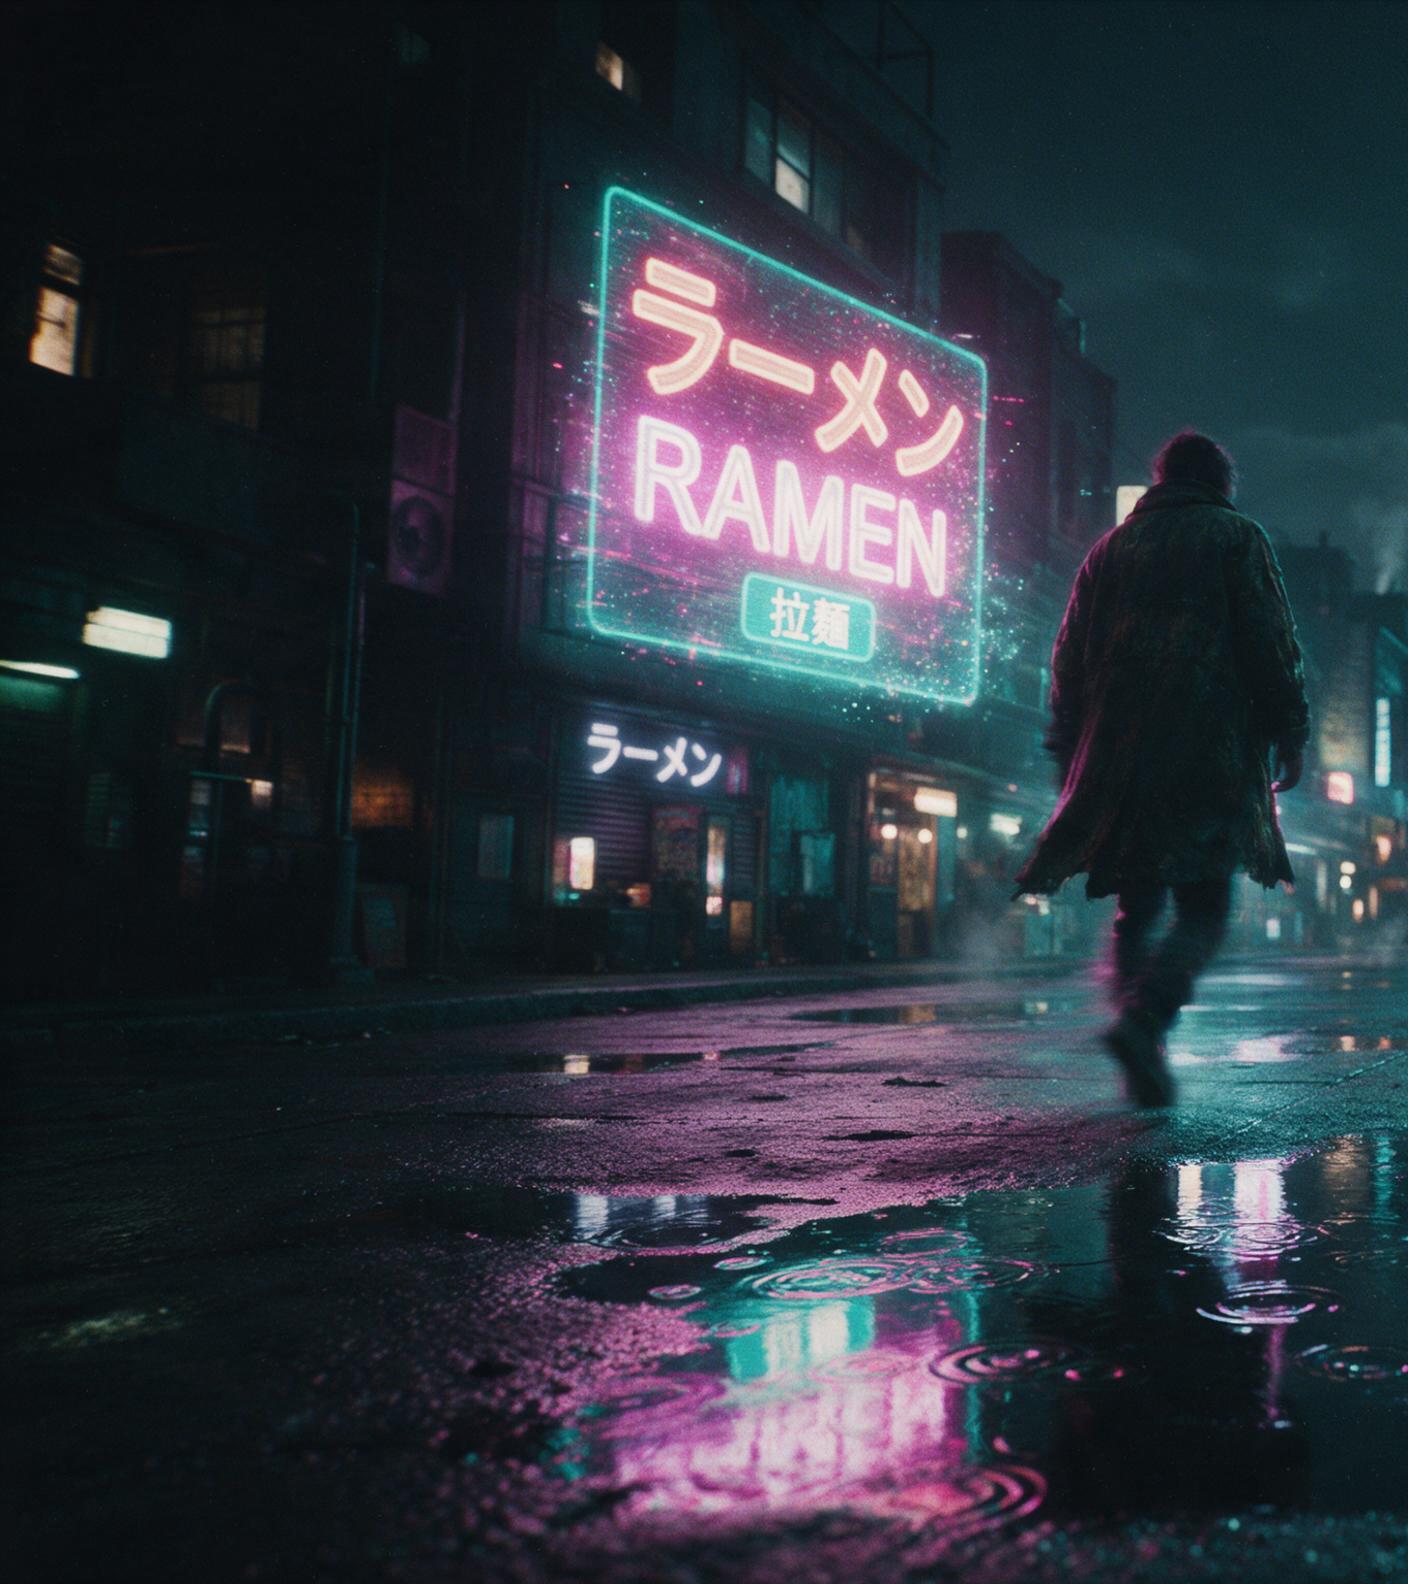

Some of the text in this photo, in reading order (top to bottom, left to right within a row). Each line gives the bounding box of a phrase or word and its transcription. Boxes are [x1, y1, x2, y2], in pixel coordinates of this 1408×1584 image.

[633, 257, 963, 476] ラーメン
[635, 416, 946, 597] RAMEN
[587, 722, 722, 787] ラーメン
